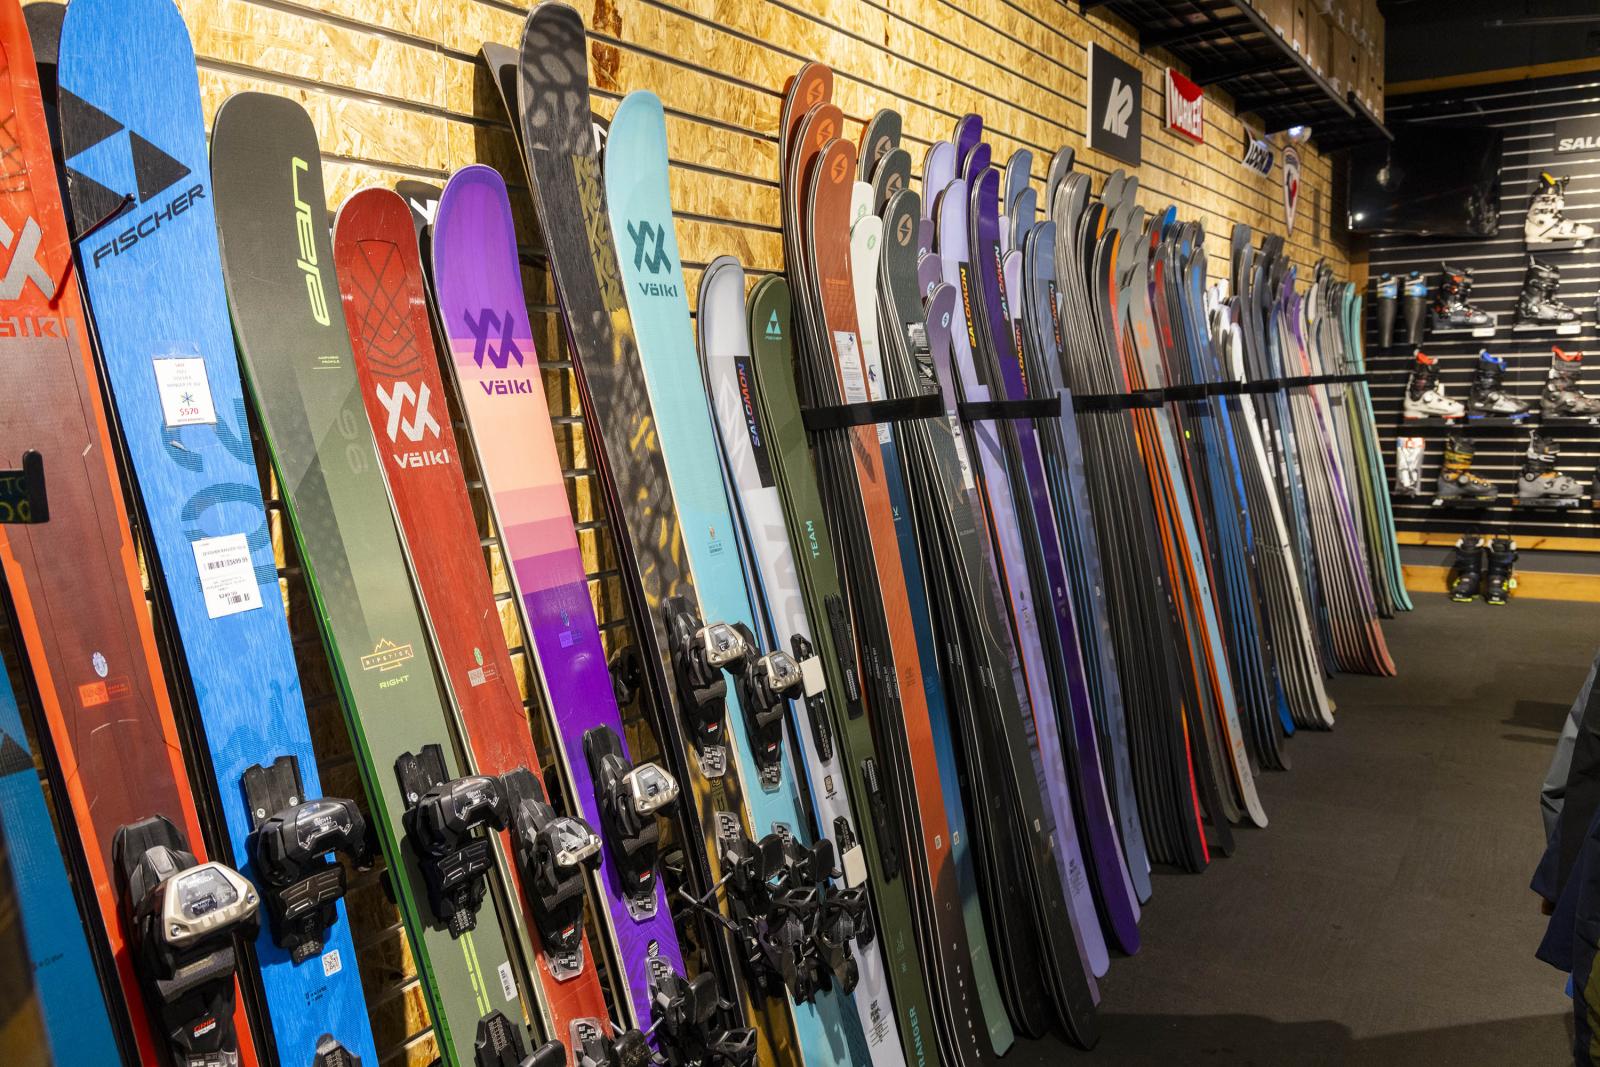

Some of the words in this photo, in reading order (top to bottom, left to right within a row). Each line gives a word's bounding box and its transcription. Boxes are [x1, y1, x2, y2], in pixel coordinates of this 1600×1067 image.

[1103, 77, 1133, 139] K2
[1171, 77, 1202, 140] MARKER
[93, 184, 206, 269] FISCHER
[638, 281, 679, 297] Völkl
[961, 267, 977, 348] SALOMON
[994, 245, 1009, 321] SALOMON
[179, 407, 199, 416] $570
[480, 378, 533, 396] Völkl
[738, 362, 760, 447] SALOMON
[393, 449, 452, 469] Völkl
[805, 520, 820, 559] TEAM
[379, 674, 409, 689] RIGHT
